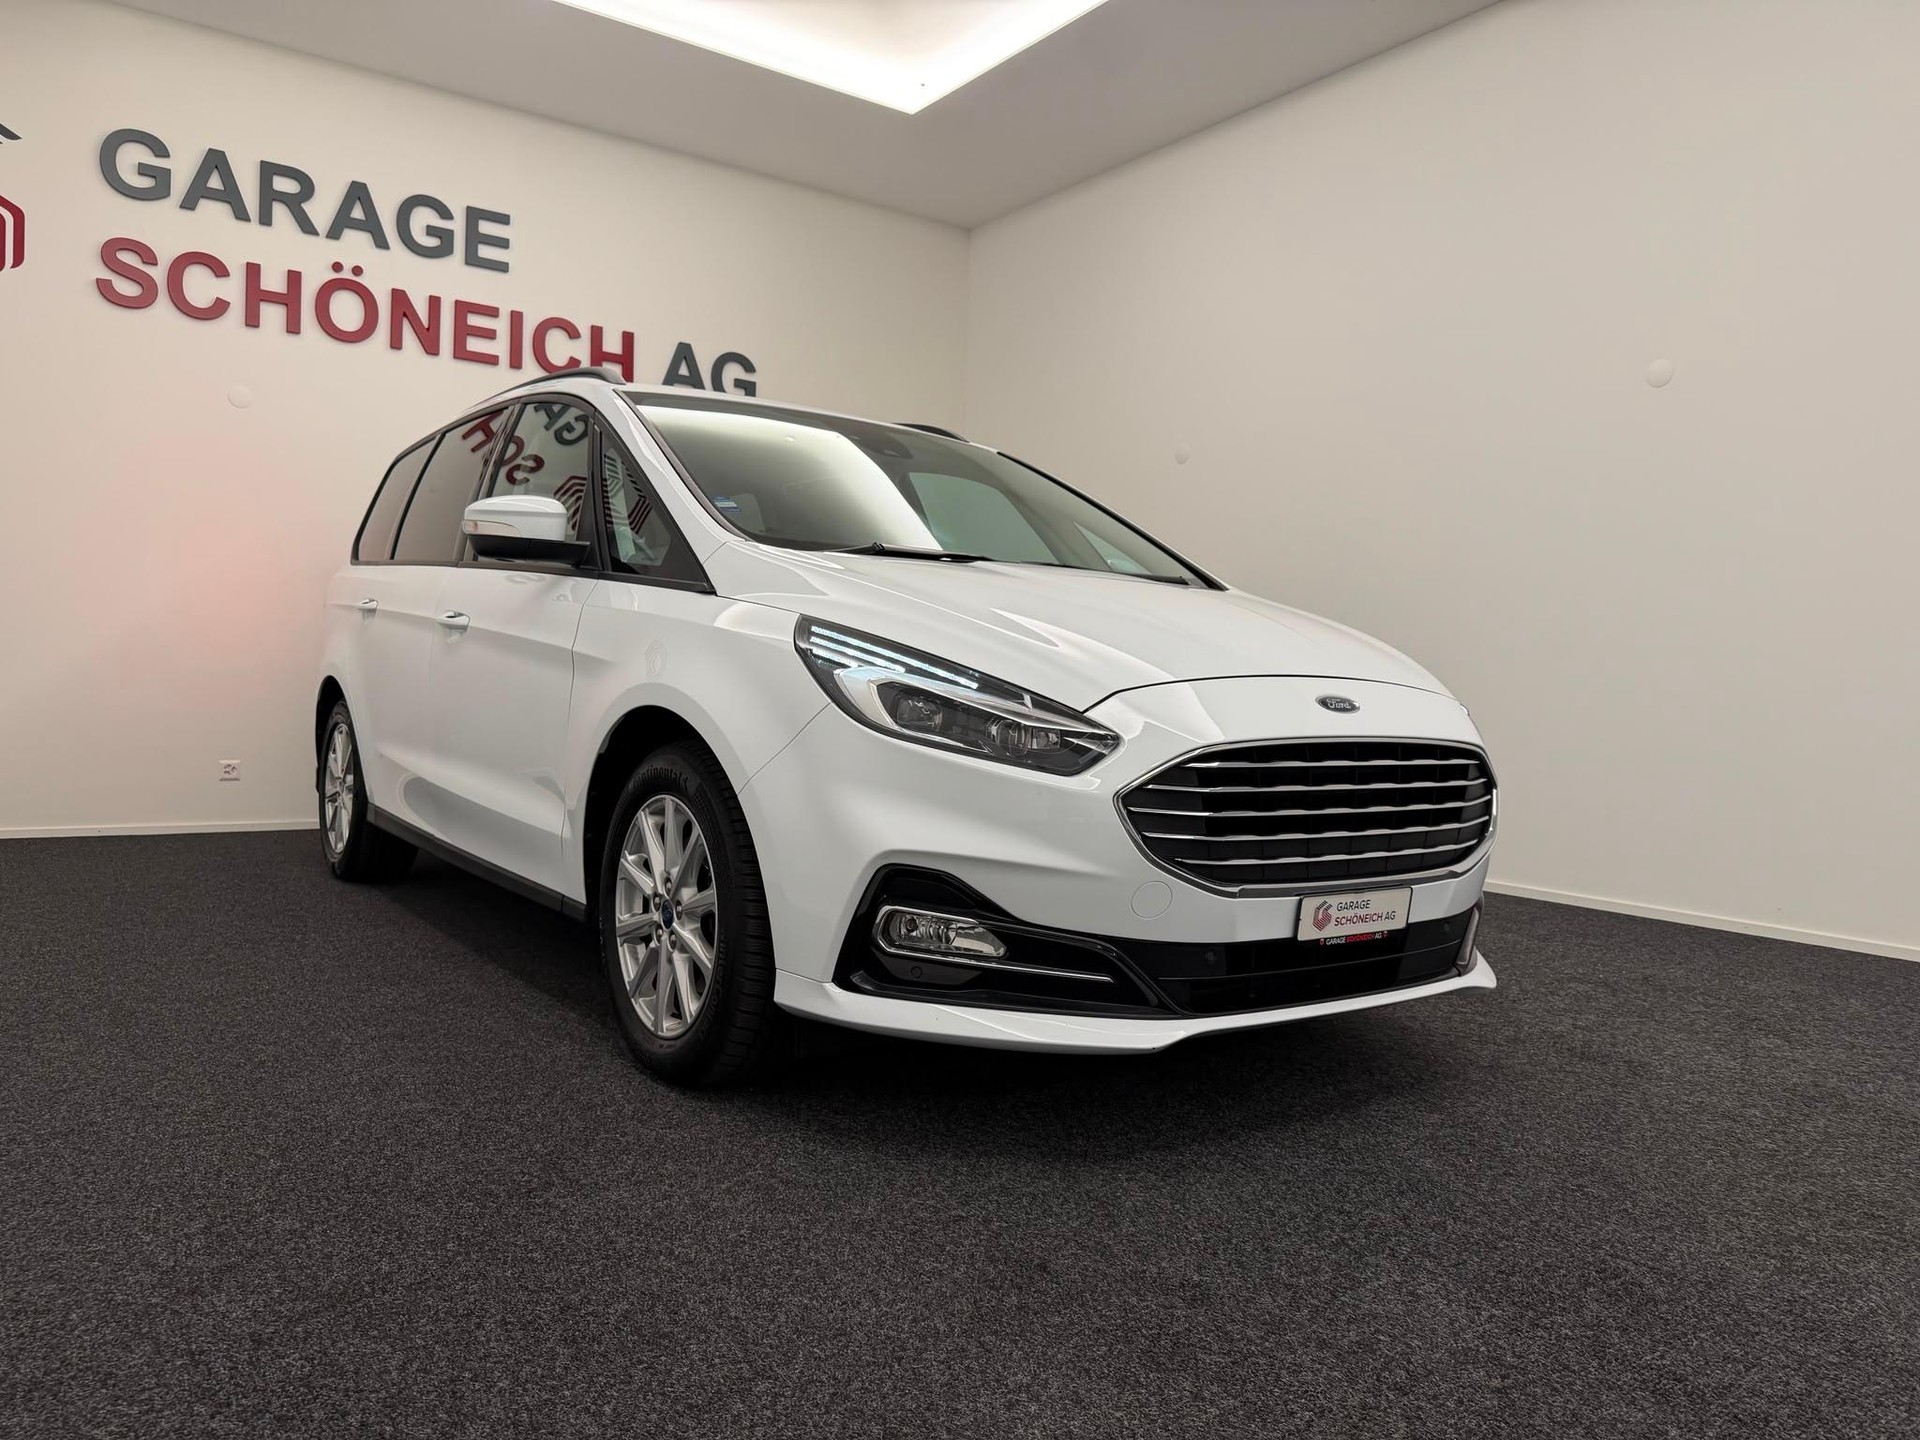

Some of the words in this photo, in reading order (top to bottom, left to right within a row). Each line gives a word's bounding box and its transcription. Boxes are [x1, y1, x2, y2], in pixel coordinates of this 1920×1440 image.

[99, 128, 511, 273] GARAGE
[96, 237, 635, 382] SCHÖNEICH
[662, 341, 756, 397] AG
[1326, 698, 1352, 710] Ford
[1336, 900, 1371, 912] GARAGE
[1334, 912, 1383, 926] SCHÖNEICH
[1384, 911, 1396, 921] AG
[1326, 936, 1346, 946] GARAGE
[1375, 932, 1383, 940] AG
